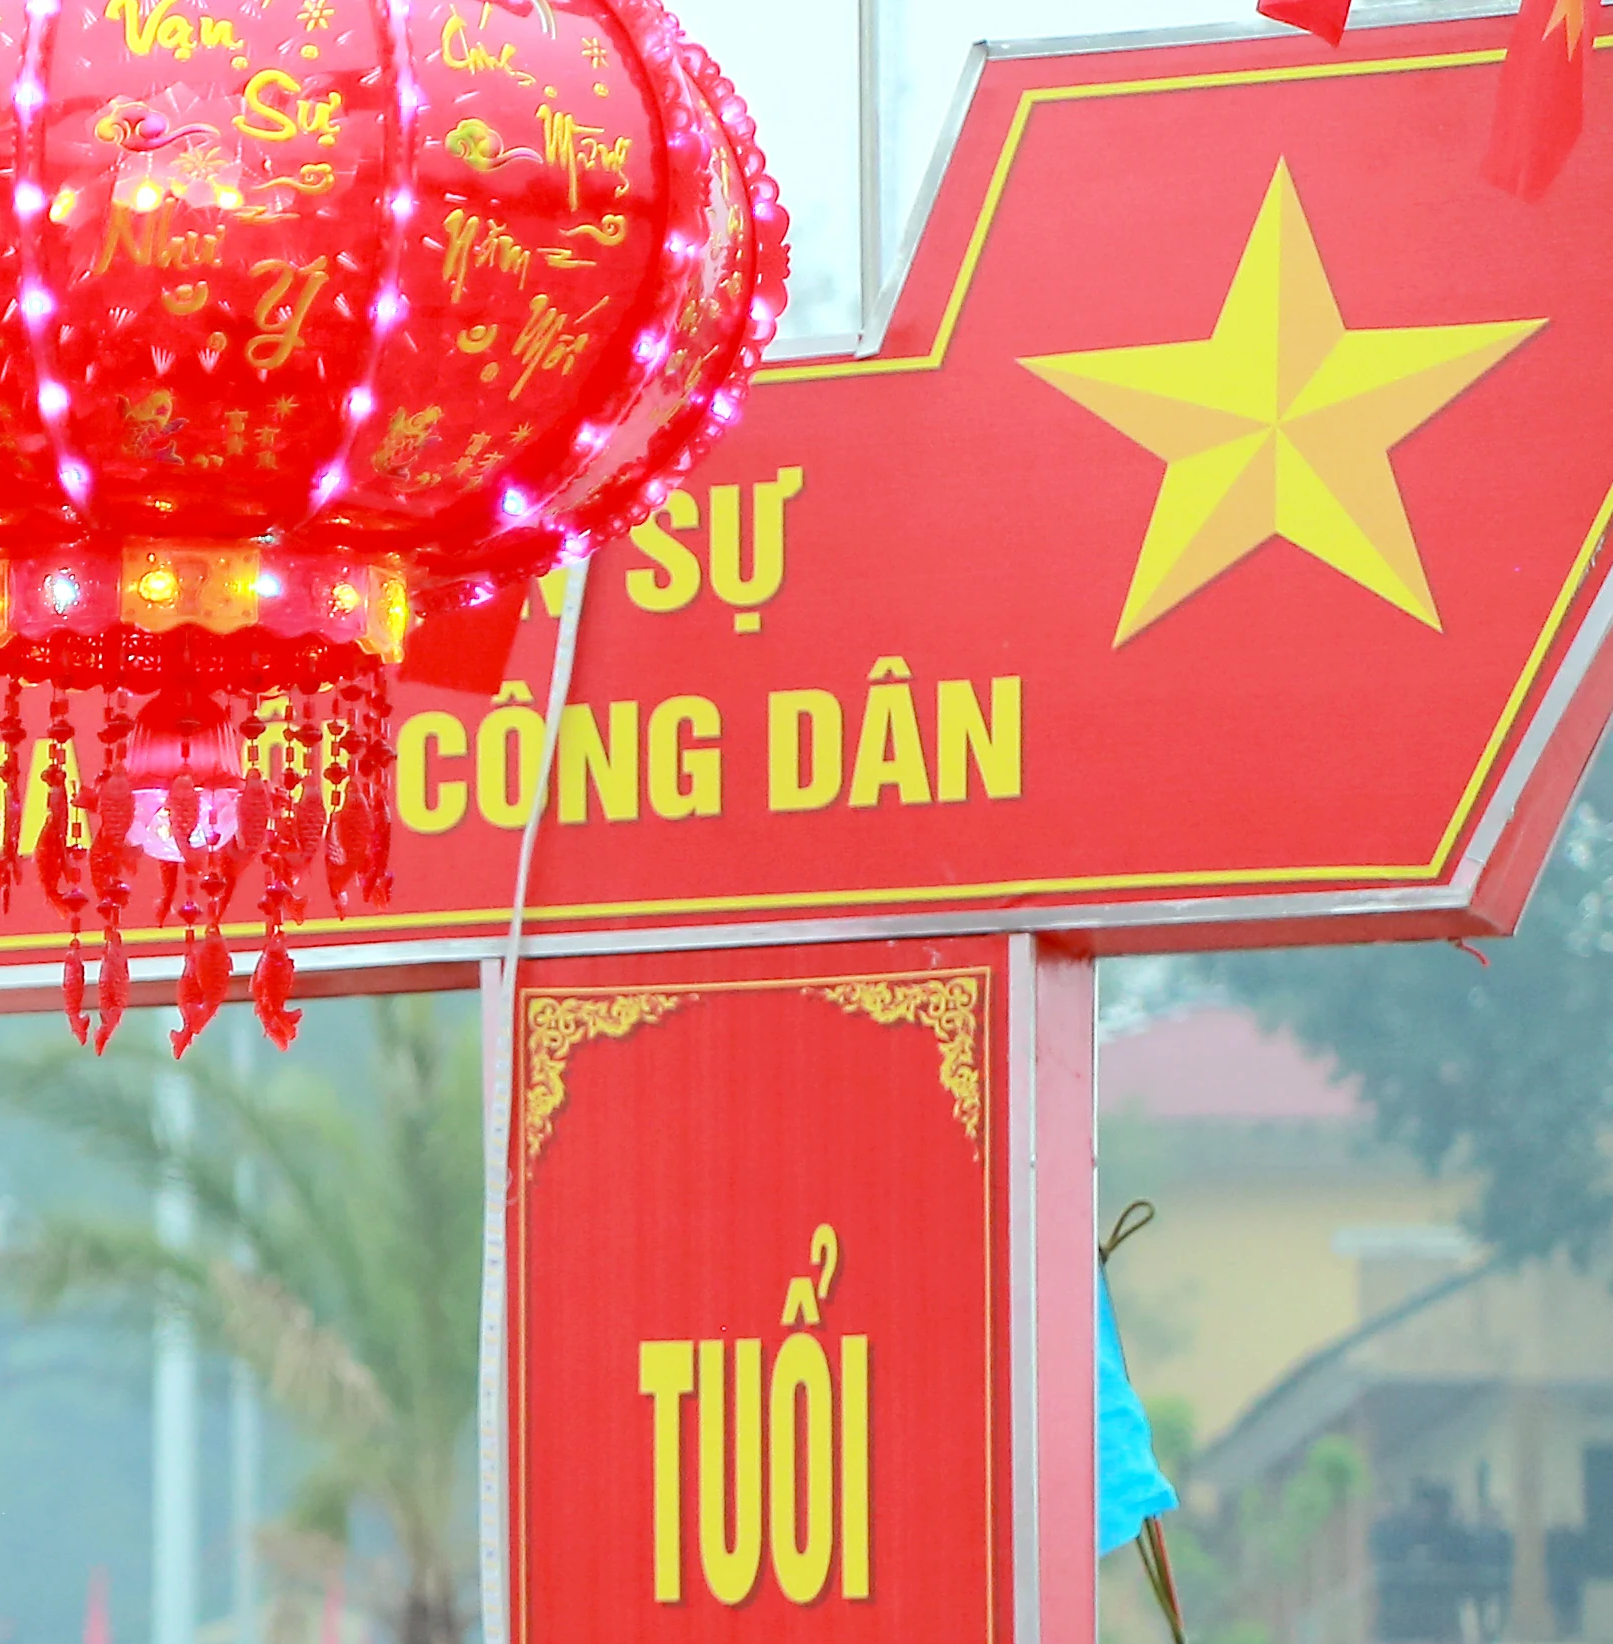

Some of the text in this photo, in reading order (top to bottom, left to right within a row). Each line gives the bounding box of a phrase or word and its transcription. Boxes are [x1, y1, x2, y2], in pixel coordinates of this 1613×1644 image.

[232, 69, 342, 146] Sự
[625, 465, 804, 634] SỰ
[395, 679, 723, 836] CÔNG
[767, 655, 1023, 814] DÂN
[637, 1223, 871, 1606] TUỔI
